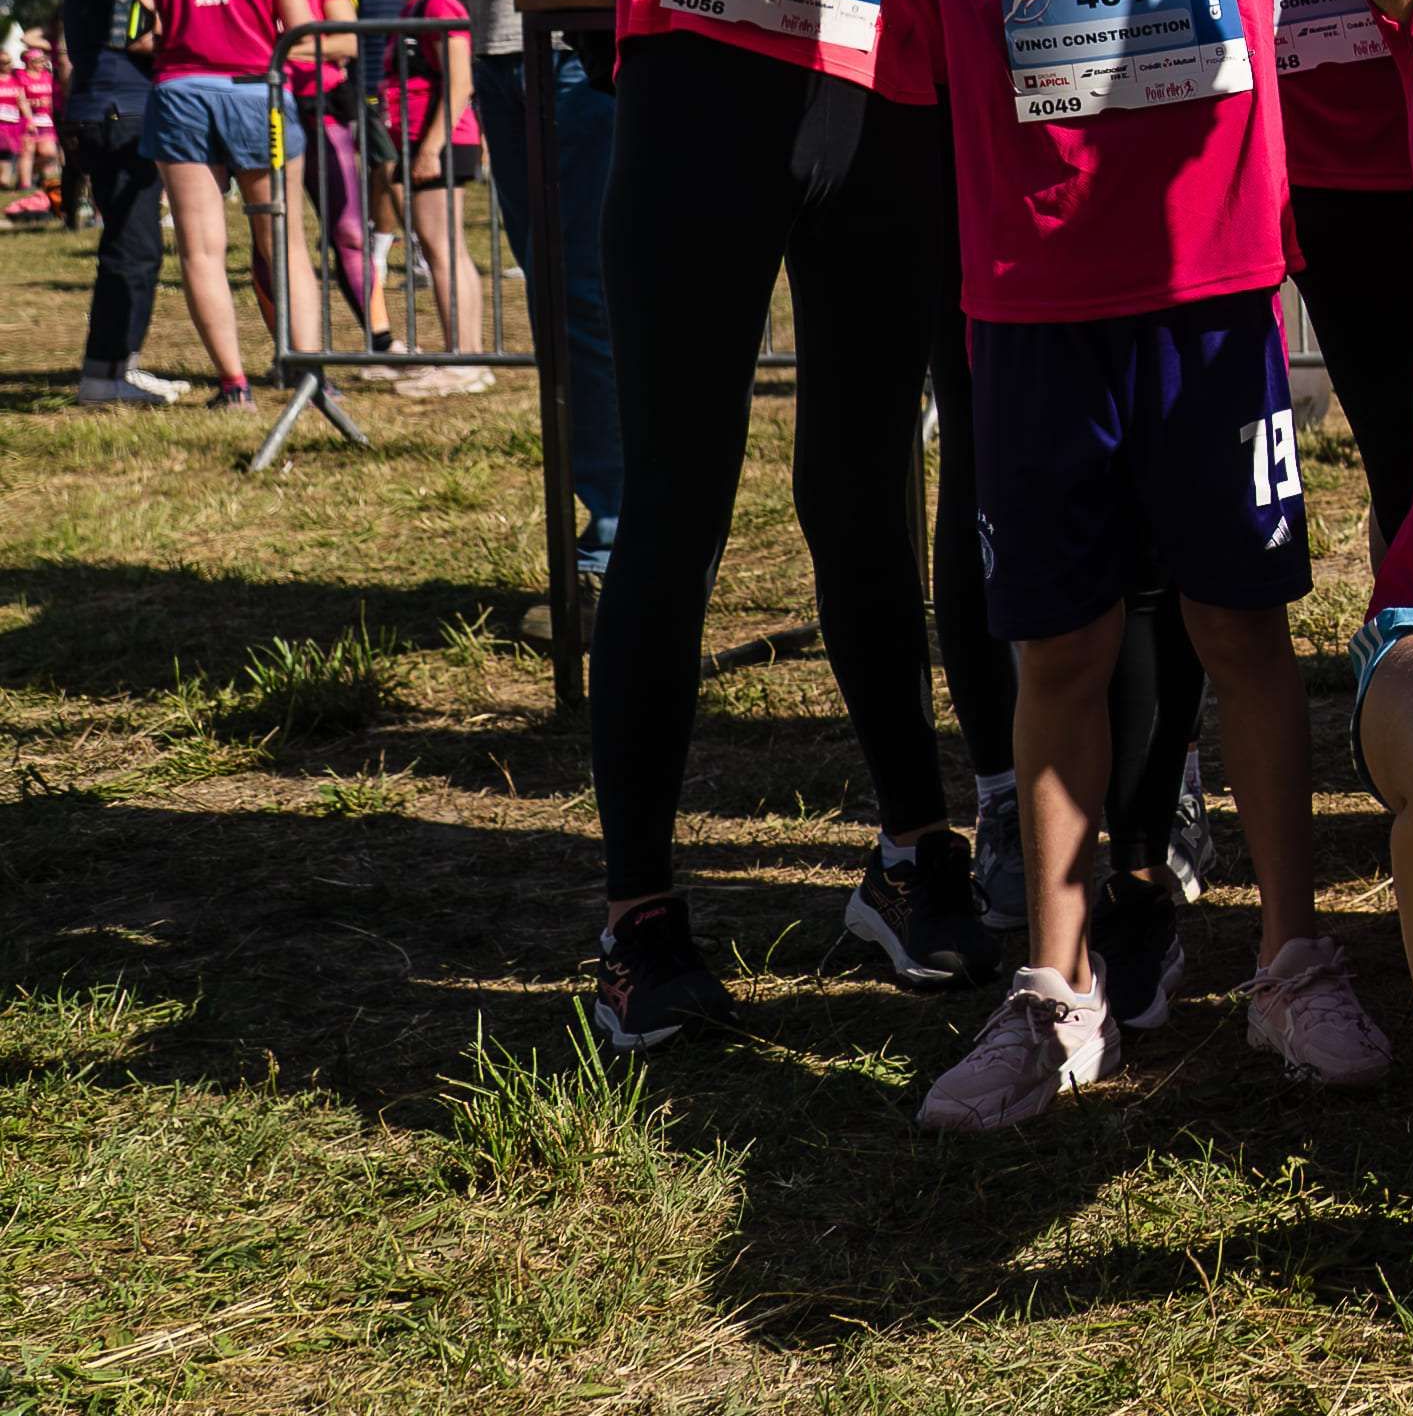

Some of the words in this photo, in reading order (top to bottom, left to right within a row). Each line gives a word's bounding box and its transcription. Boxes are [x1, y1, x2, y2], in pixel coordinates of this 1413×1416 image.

[1015, 35, 1058, 53] VINCI
[1062, 18, 1191, 48] CONSTRUCTION
[1276, 54, 1300, 70] 48
[1039, 76, 1071, 88] APICIL
[1028, 96, 1082, 116] 4049
